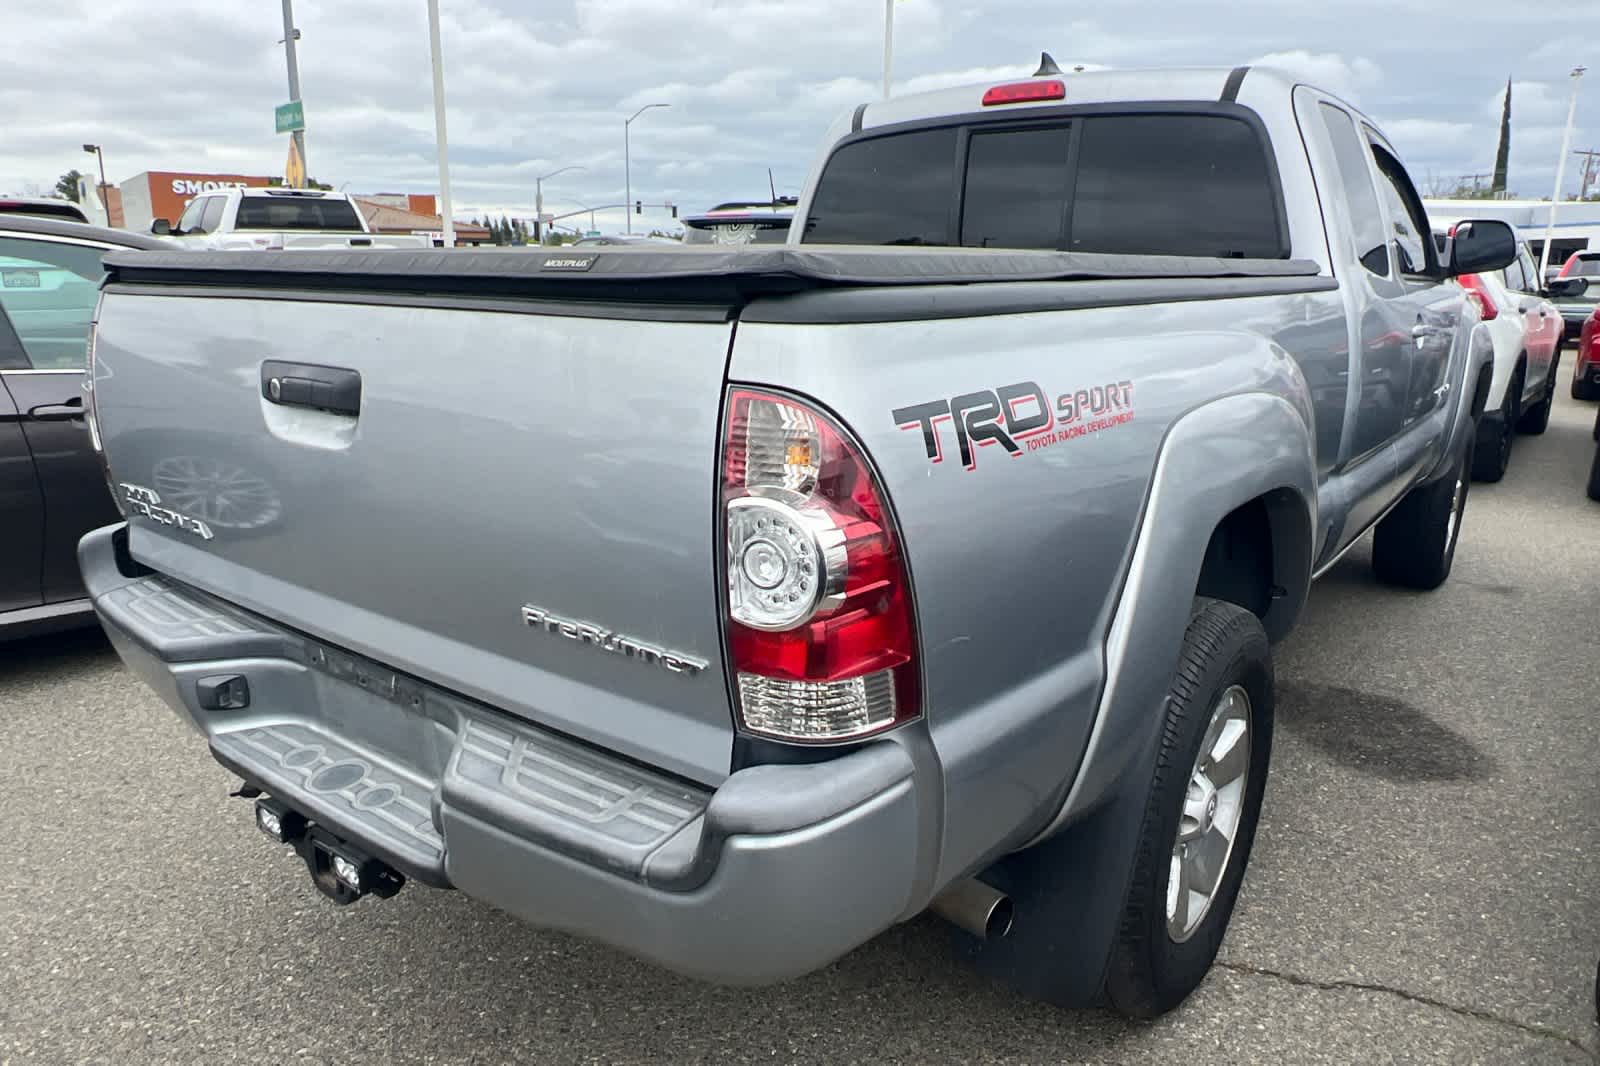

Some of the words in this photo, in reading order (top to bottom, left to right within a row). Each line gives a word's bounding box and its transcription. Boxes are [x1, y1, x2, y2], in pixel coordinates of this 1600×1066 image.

[891, 381, 1055, 471] TRD
[1056, 380, 1134, 424] SPORT
[1025, 434, 1057, 452] TOYOTA
[1058, 425, 1087, 442] RACING
[1087, 411, 1134, 432] DEVELOPMENT
